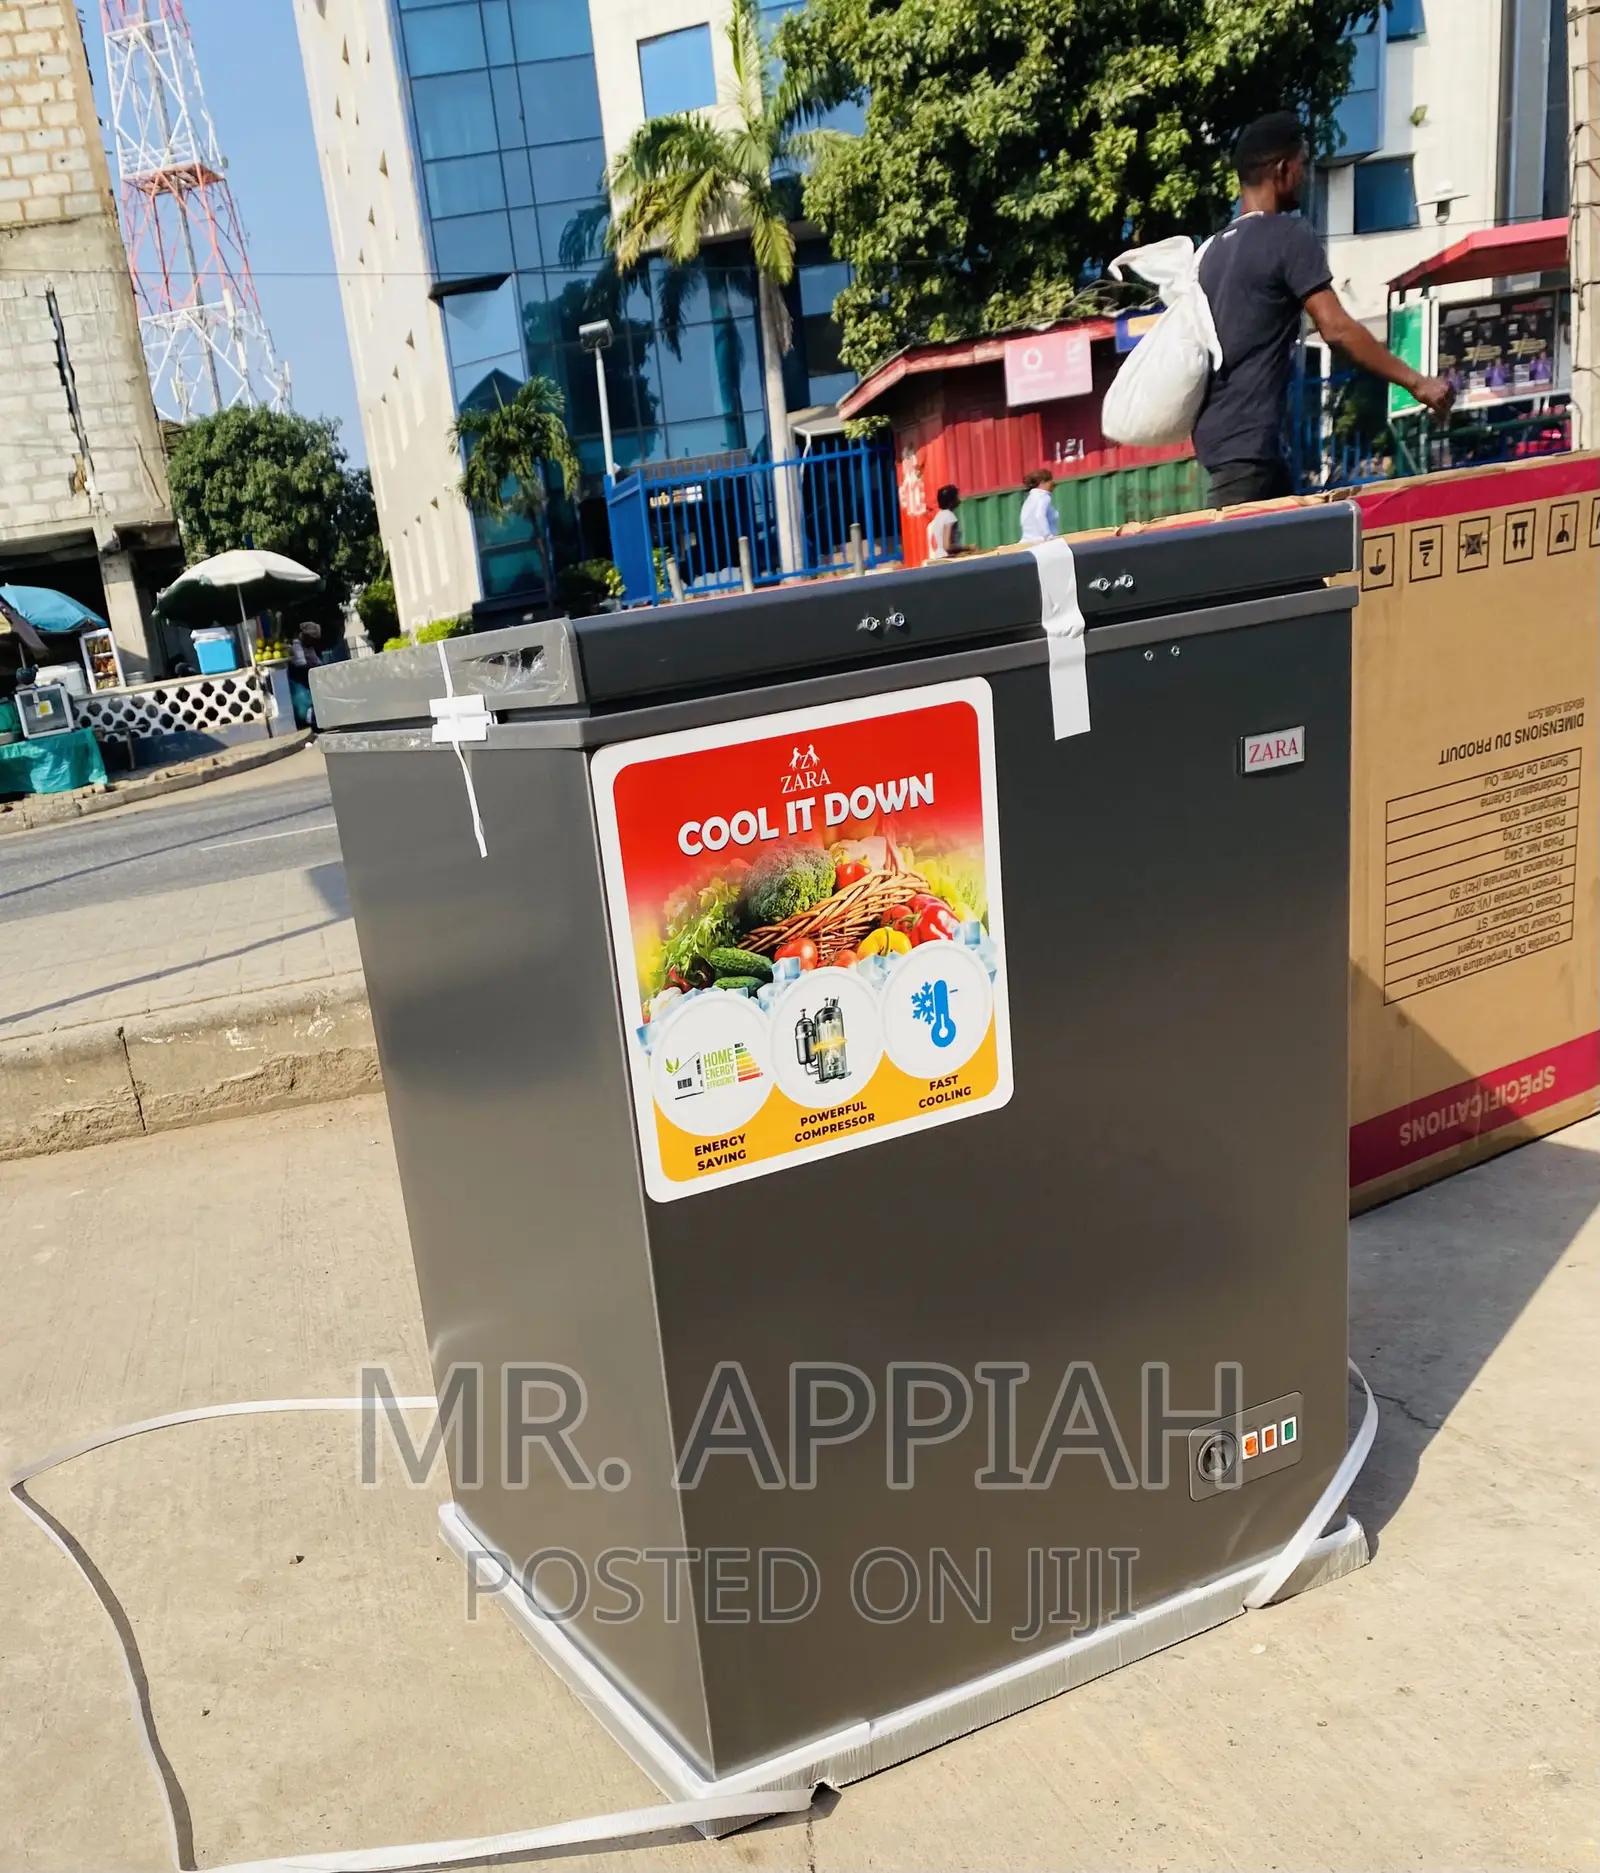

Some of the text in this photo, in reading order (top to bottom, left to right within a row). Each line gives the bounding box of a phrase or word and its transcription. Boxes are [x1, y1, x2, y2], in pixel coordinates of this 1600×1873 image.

[1422, 552, 1430, 567] 2
[1438, 712, 1585, 765] DIMENSIONS DU PRODUIT
[1249, 736, 1299, 764] ZARA
[1526, 763, 1538, 776] De
[780, 768, 832, 794] ZARA
[1484, 774, 1499, 788] Oui
[1514, 775, 1568, 798] Condensateur
[677, 772, 935, 856] COOL IT DOWN
[1500, 808, 1520, 823] 600a
[1544, 815, 1566, 828] Poids
[1502, 828, 1522, 842] 27kg
[1543, 834, 1565, 849] Poids
[1504, 847, 1524, 861] 24kg
[1484, 868, 1521, 887] Nominale
[1532, 874, 1562, 891] Tension
[1449, 887, 1461, 900] 50
[1494, 884, 1530, 903] Nominale
[1535, 893, 1562, 909] Classe
[1453, 901, 1476, 919] 220V
[1476, 917, 1489, 931] ST
[1518, 922, 1529, 935] Du
[1531, 912, 1561, 929] Couleur
[1457, 937, 1484, 956] Argent
[1515, 942, 1526, 954] De
[703, 1047, 735, 1069] HOME
[704, 1063, 735, 1081] ENERGY
[706, 1075, 737, 1091] EFFICIENCY
[929, 1075, 959, 1092] FAST
[918, 1086, 972, 1109] COOLING
[1400, 1065, 1556, 1147] SPÉCIFICATIONS
[799, 1101, 868, 1127] POWERFUL
[794, 1112, 876, 1143] COMPRESSOR
[694, 1133, 747, 1157] ENERGY
[697, 1149, 747, 1172] SAVING
